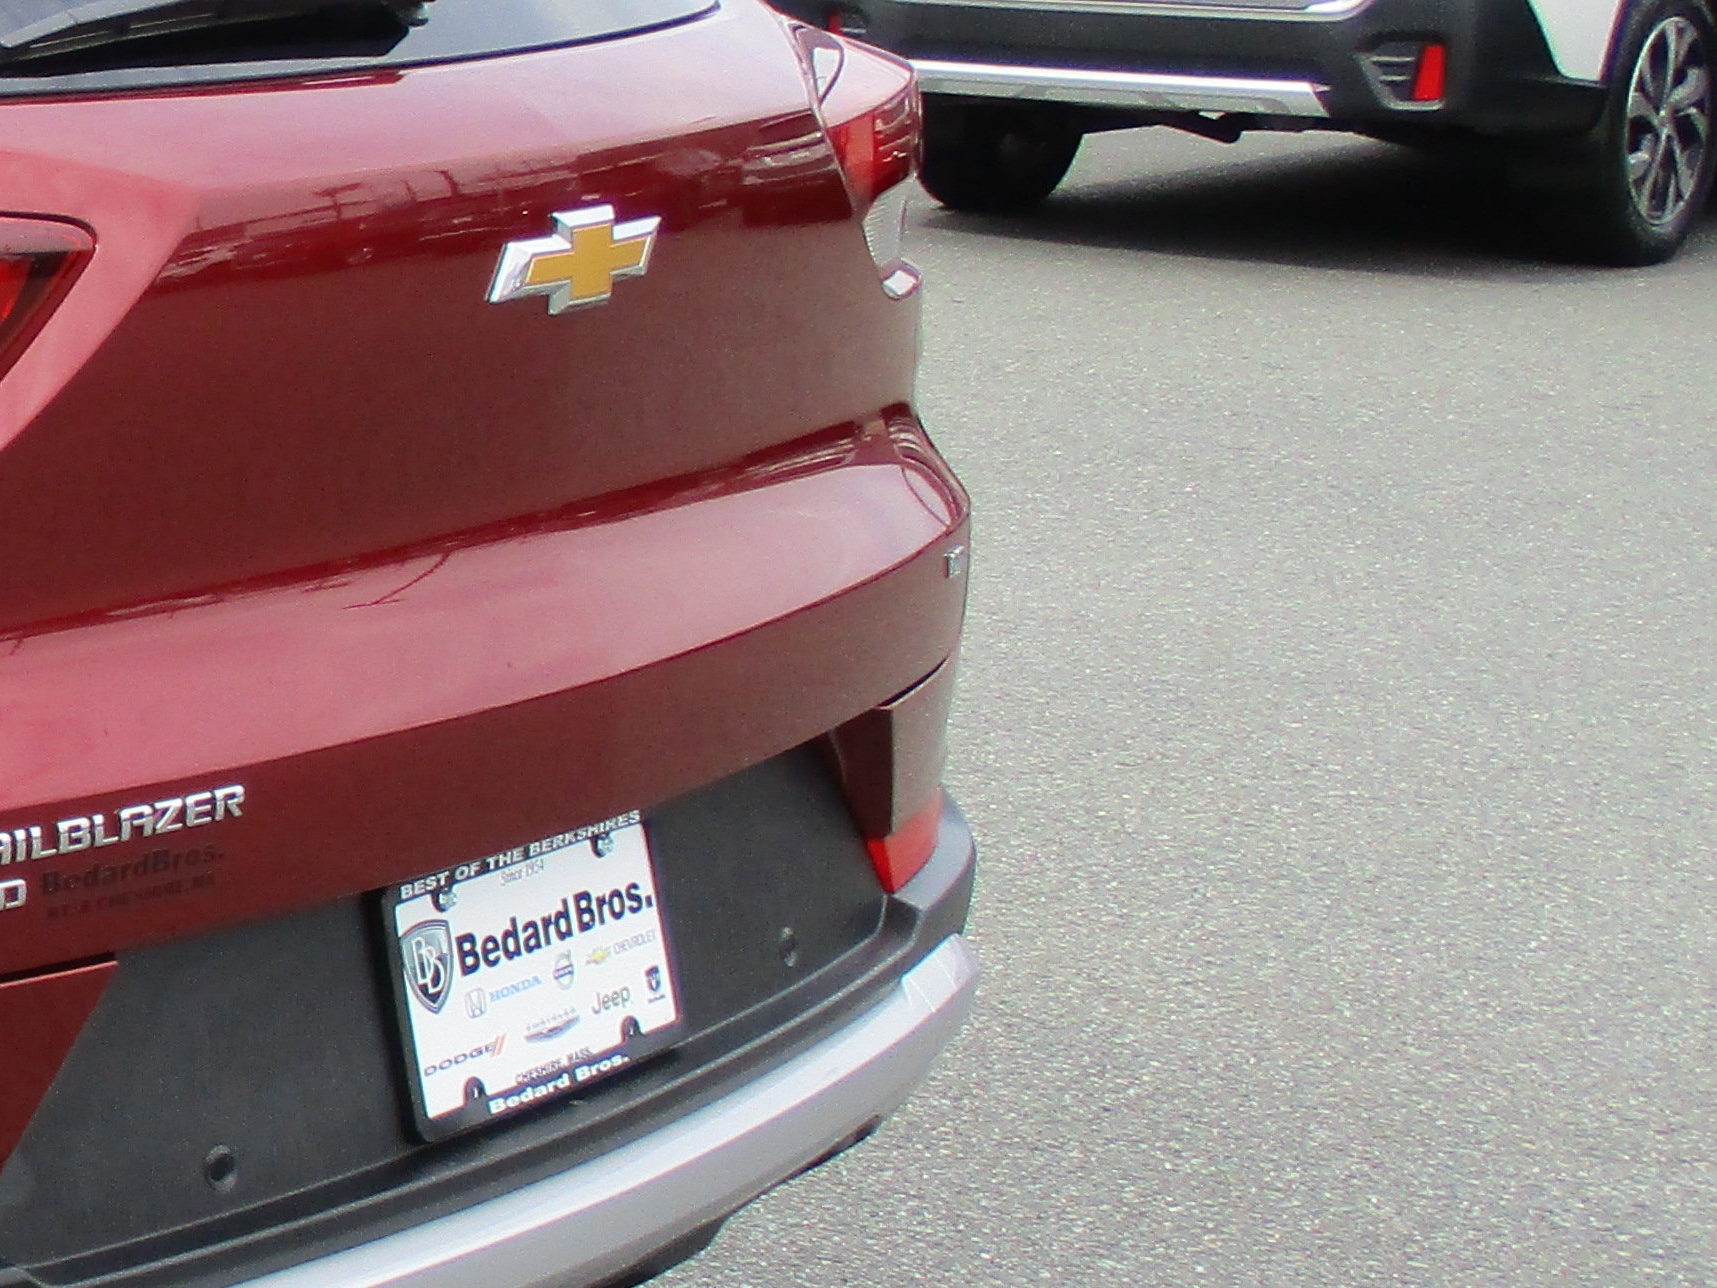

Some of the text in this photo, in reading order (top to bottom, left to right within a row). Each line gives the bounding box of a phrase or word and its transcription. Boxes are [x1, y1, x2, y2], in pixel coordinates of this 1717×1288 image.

[400, 870, 450, 899] BEST
[455, 861, 482, 880] OF
[486, 847, 525, 870] THE
[490, 976, 542, 1002] HONDA
[592, 986, 630, 1015] Jeep
[424, 1041, 496, 1076] DODGE
[488, 1055, 631, 1114] Bedard Bros.
